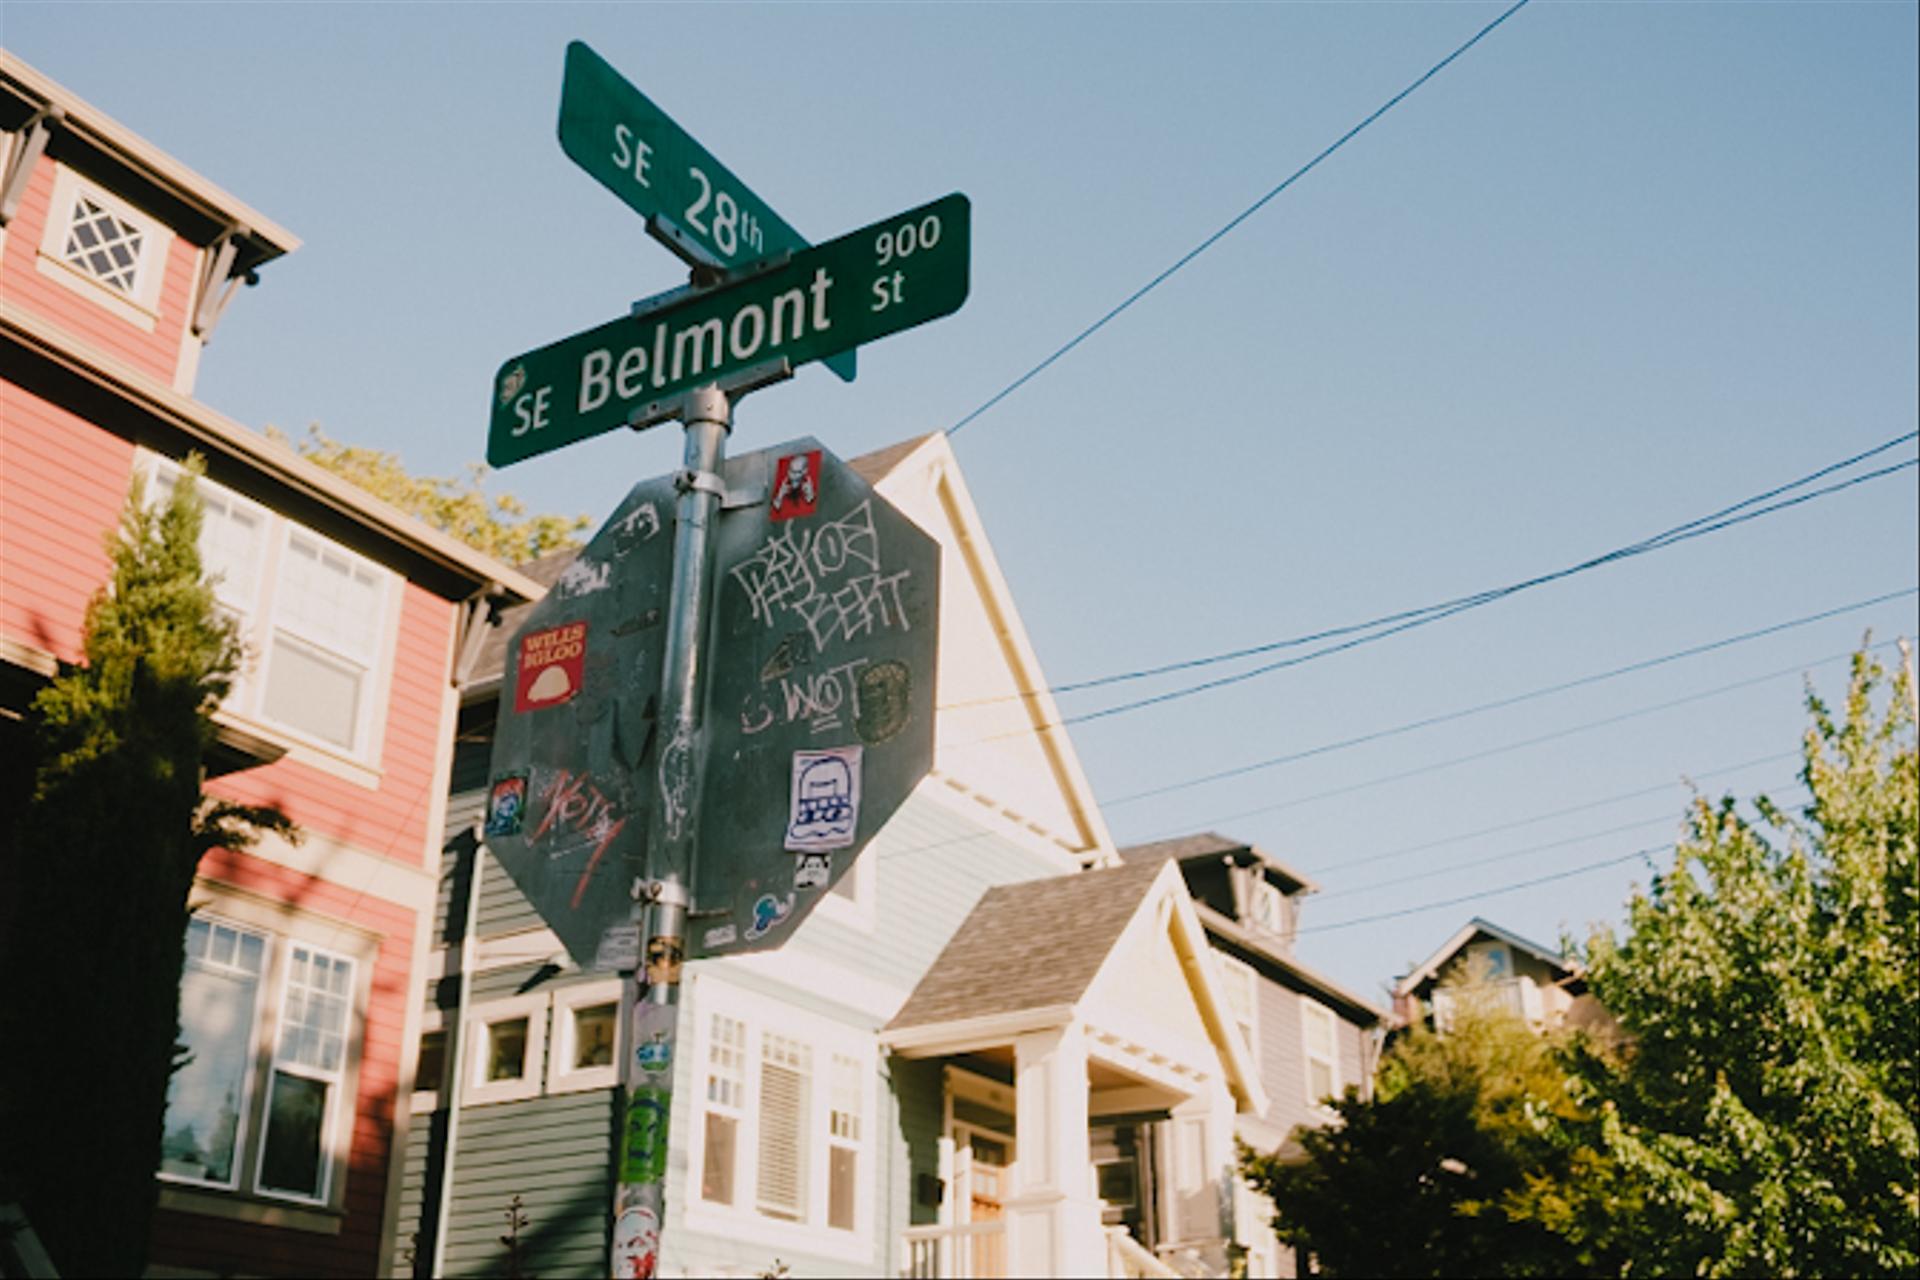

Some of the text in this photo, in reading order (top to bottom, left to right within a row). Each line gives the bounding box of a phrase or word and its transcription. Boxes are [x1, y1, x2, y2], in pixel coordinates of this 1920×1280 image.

[612, 124, 764, 258] SE 28th
[874, 215, 942, 267] 900
[510, 267, 906, 437] SE Belmont St
[524, 641, 583, 669] IGLOO
